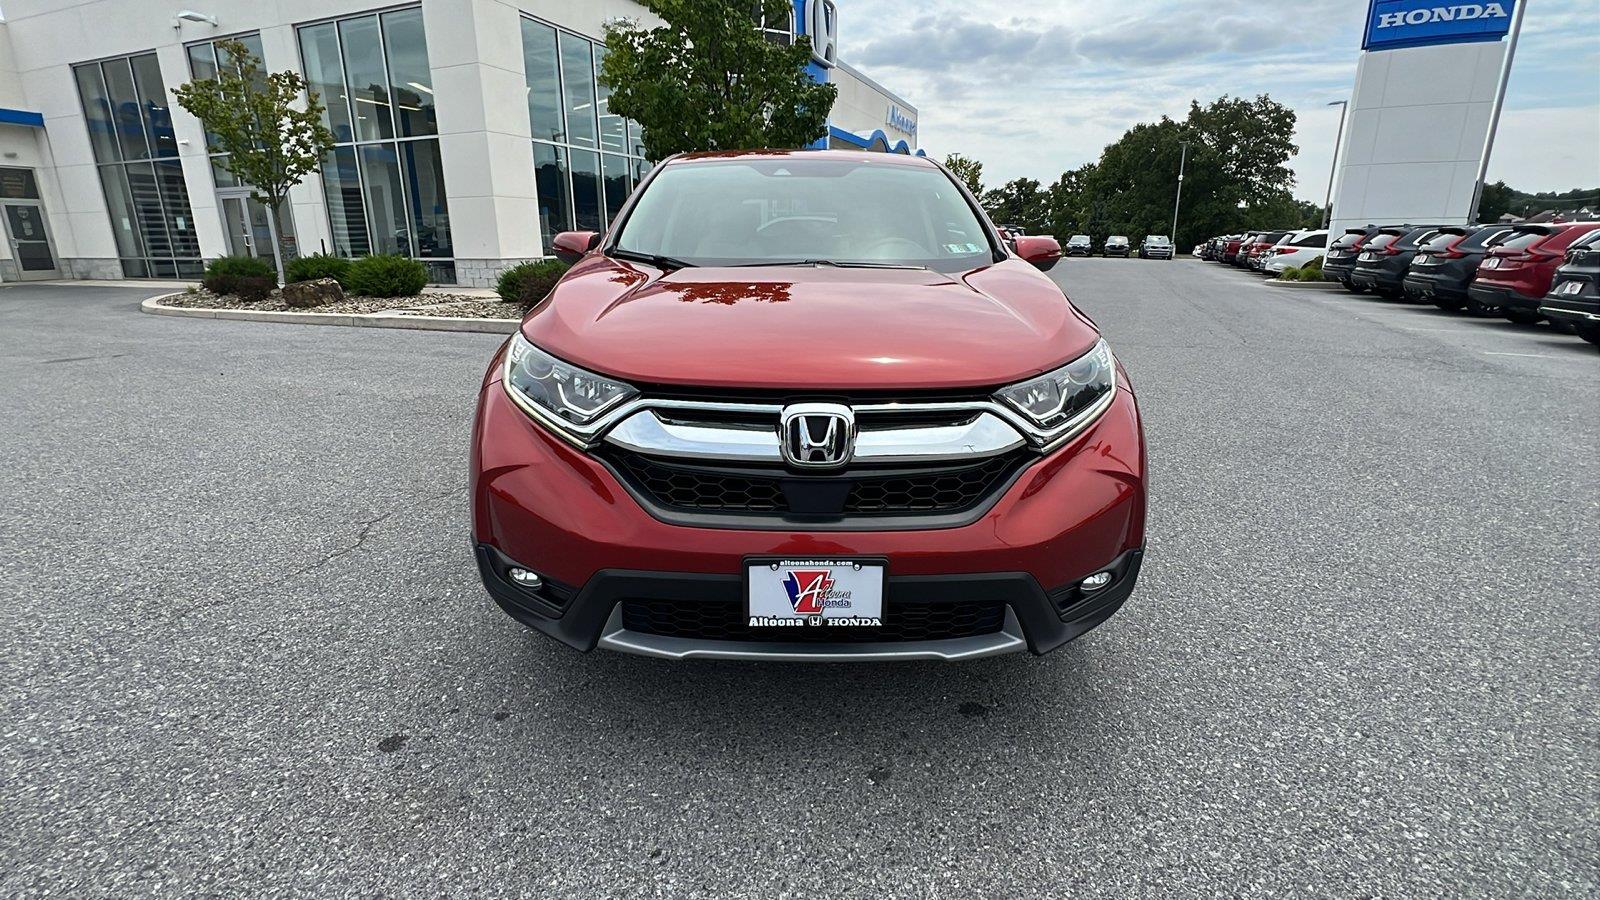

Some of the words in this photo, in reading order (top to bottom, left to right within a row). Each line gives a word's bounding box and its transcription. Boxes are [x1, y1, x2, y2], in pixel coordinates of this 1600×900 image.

[1377, 3, 1507, 28] HONDA
[817, 598, 851, 608] Honda
[749, 617, 804, 627] Altoona
[827, 617, 882, 627] HONDA
